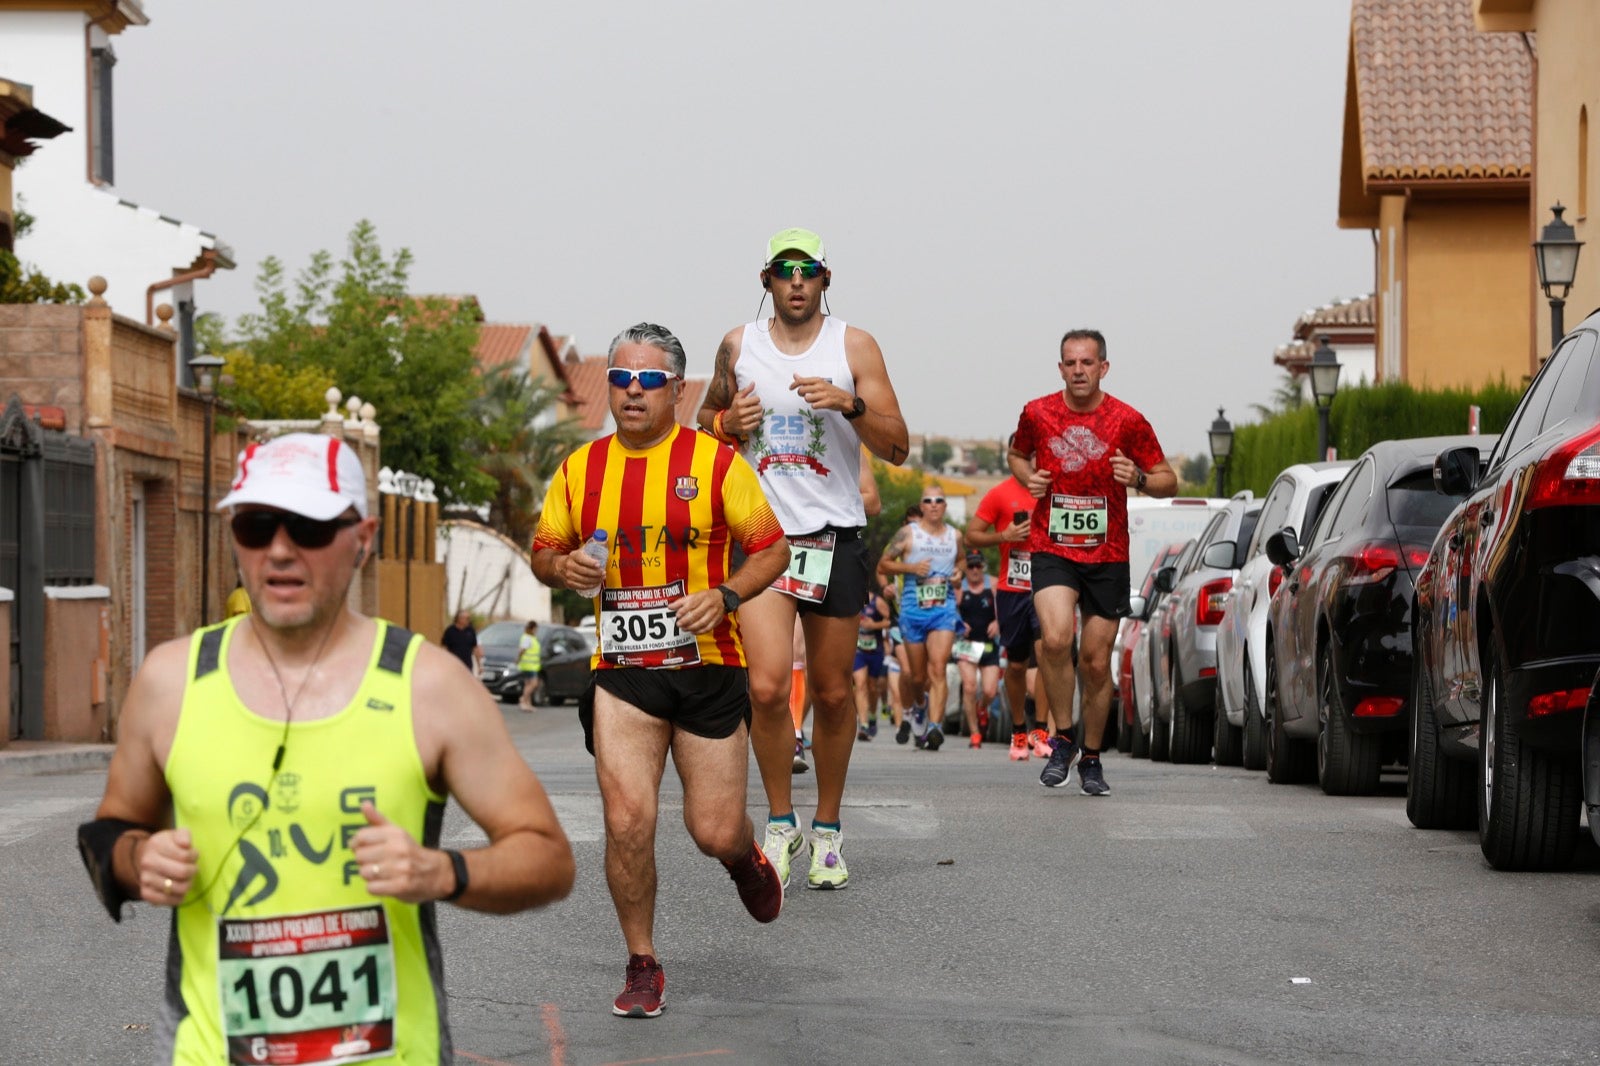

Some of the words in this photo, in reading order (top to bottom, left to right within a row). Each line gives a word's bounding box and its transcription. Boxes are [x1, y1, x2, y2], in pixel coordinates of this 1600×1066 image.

[770, 415, 804, 435] 25
[1060, 512, 1099, 530] 156
[612, 525, 701, 555] ATAR
[611, 557, 662, 569] AIRWAYS
[788, 550, 808, 576] 1
[1013, 561, 1029, 575] 30
[617, 590, 632, 601] GRAN
[632, 589, 653, 600] PREMIO
[654, 588, 662, 599] DE
[663, 584, 681, 597] FONDO
[611, 611, 681, 643] 3057
[649, 642, 665, 650] FONDO
[253, 921, 283, 941] GRAN
[283, 916, 325, 938] PREMIO
[325, 914, 341, 934] DE
[341, 909, 379, 932] FONDO
[233, 954, 381, 1021] 1041
